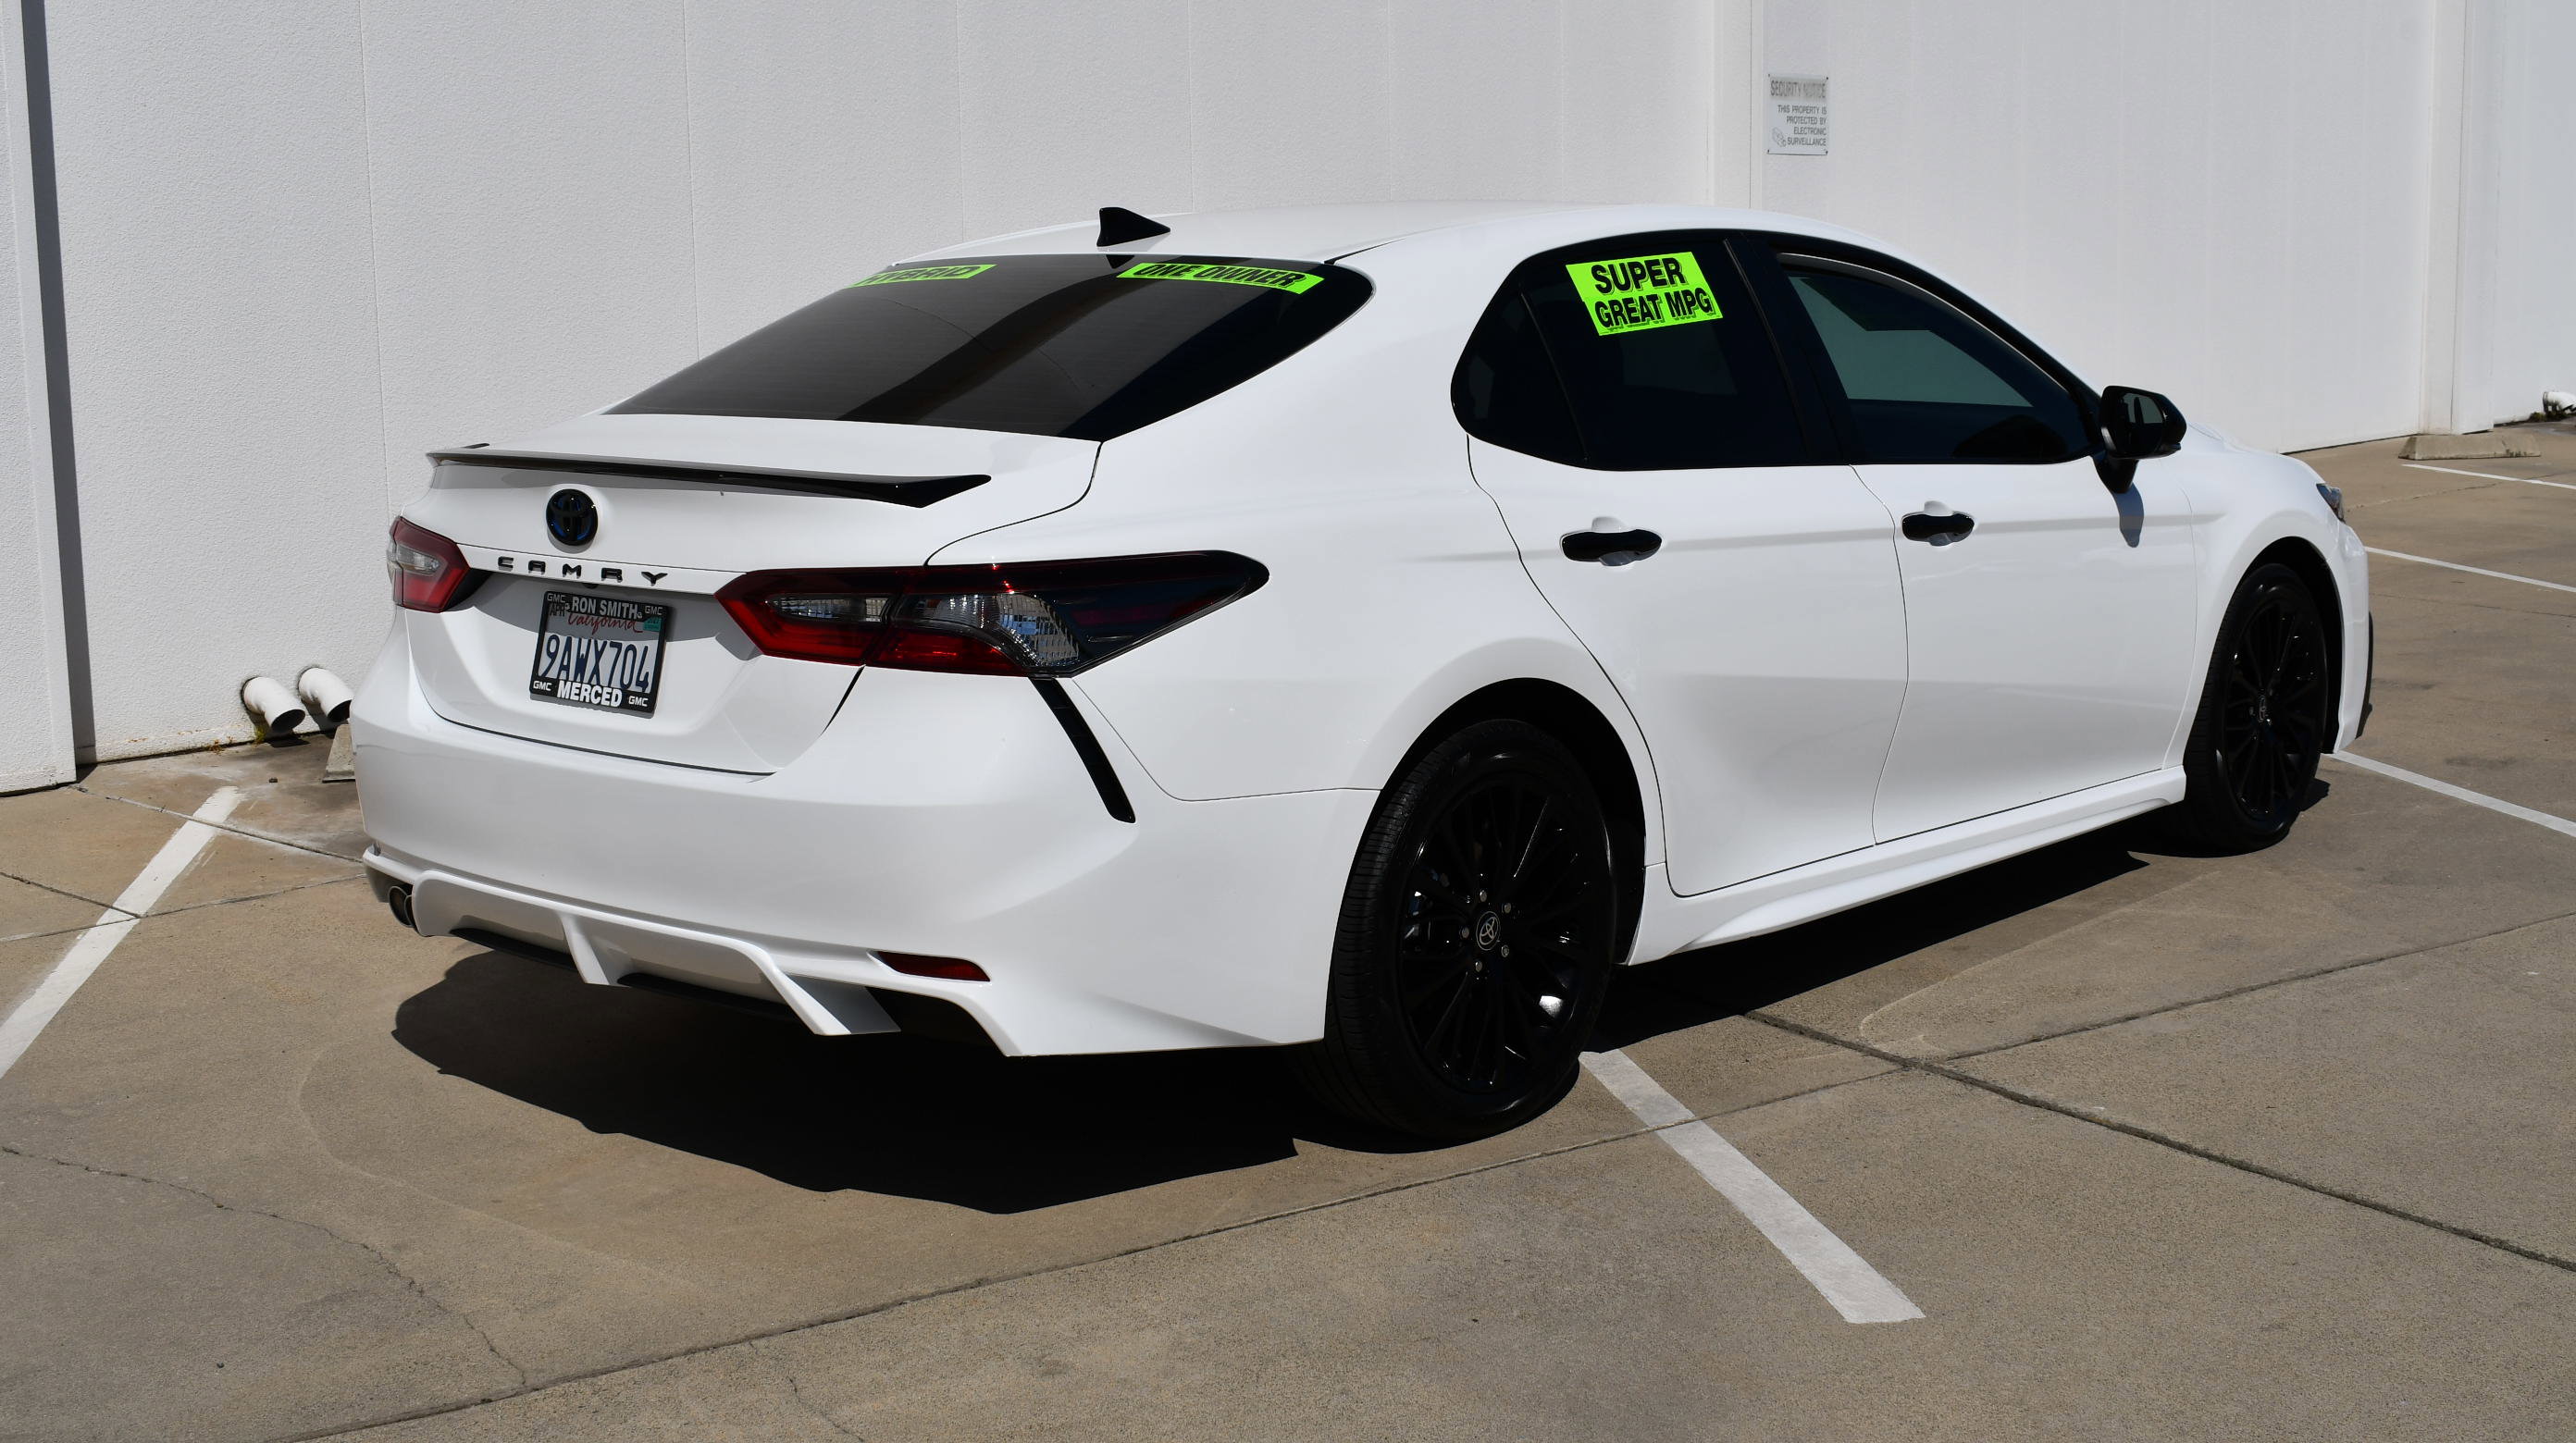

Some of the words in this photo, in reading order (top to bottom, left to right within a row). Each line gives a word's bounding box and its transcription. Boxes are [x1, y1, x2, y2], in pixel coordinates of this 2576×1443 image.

[1770, 80, 1802, 97] SECURITY
[1777, 105, 1790, 114] THIS
[1791, 105, 1820, 115] PROPERTY
[1821, 106, 1827, 115] IS
[1786, 116, 1817, 125] PROTECTED
[1819, 117, 1827, 126] BY
[1793, 126, 1827, 136] ELECTRONIC
[1787, 137, 1827, 146] SURVEILLANCE
[1133, 264, 1200, 278] ONE
[1194, 266, 1307, 289] OWNER
[1591, 257, 1689, 296] SUPER
[1594, 293, 1665, 330] GREAT
[1664, 287, 1715, 321] MPG
[497, 556, 668, 586] CAMRY
[547, 593, 566, 603] GMC
[572, 596, 597, 616] RON
[599, 600, 638, 620] SMITH
[644, 605, 663, 616] GMC
[567, 612, 644, 635] California
[541, 634, 650, 694] 9AWX704
[533, 681, 552, 691] GMC
[557, 680, 623, 708] MERCED
[628, 696, 649, 708] GMC
